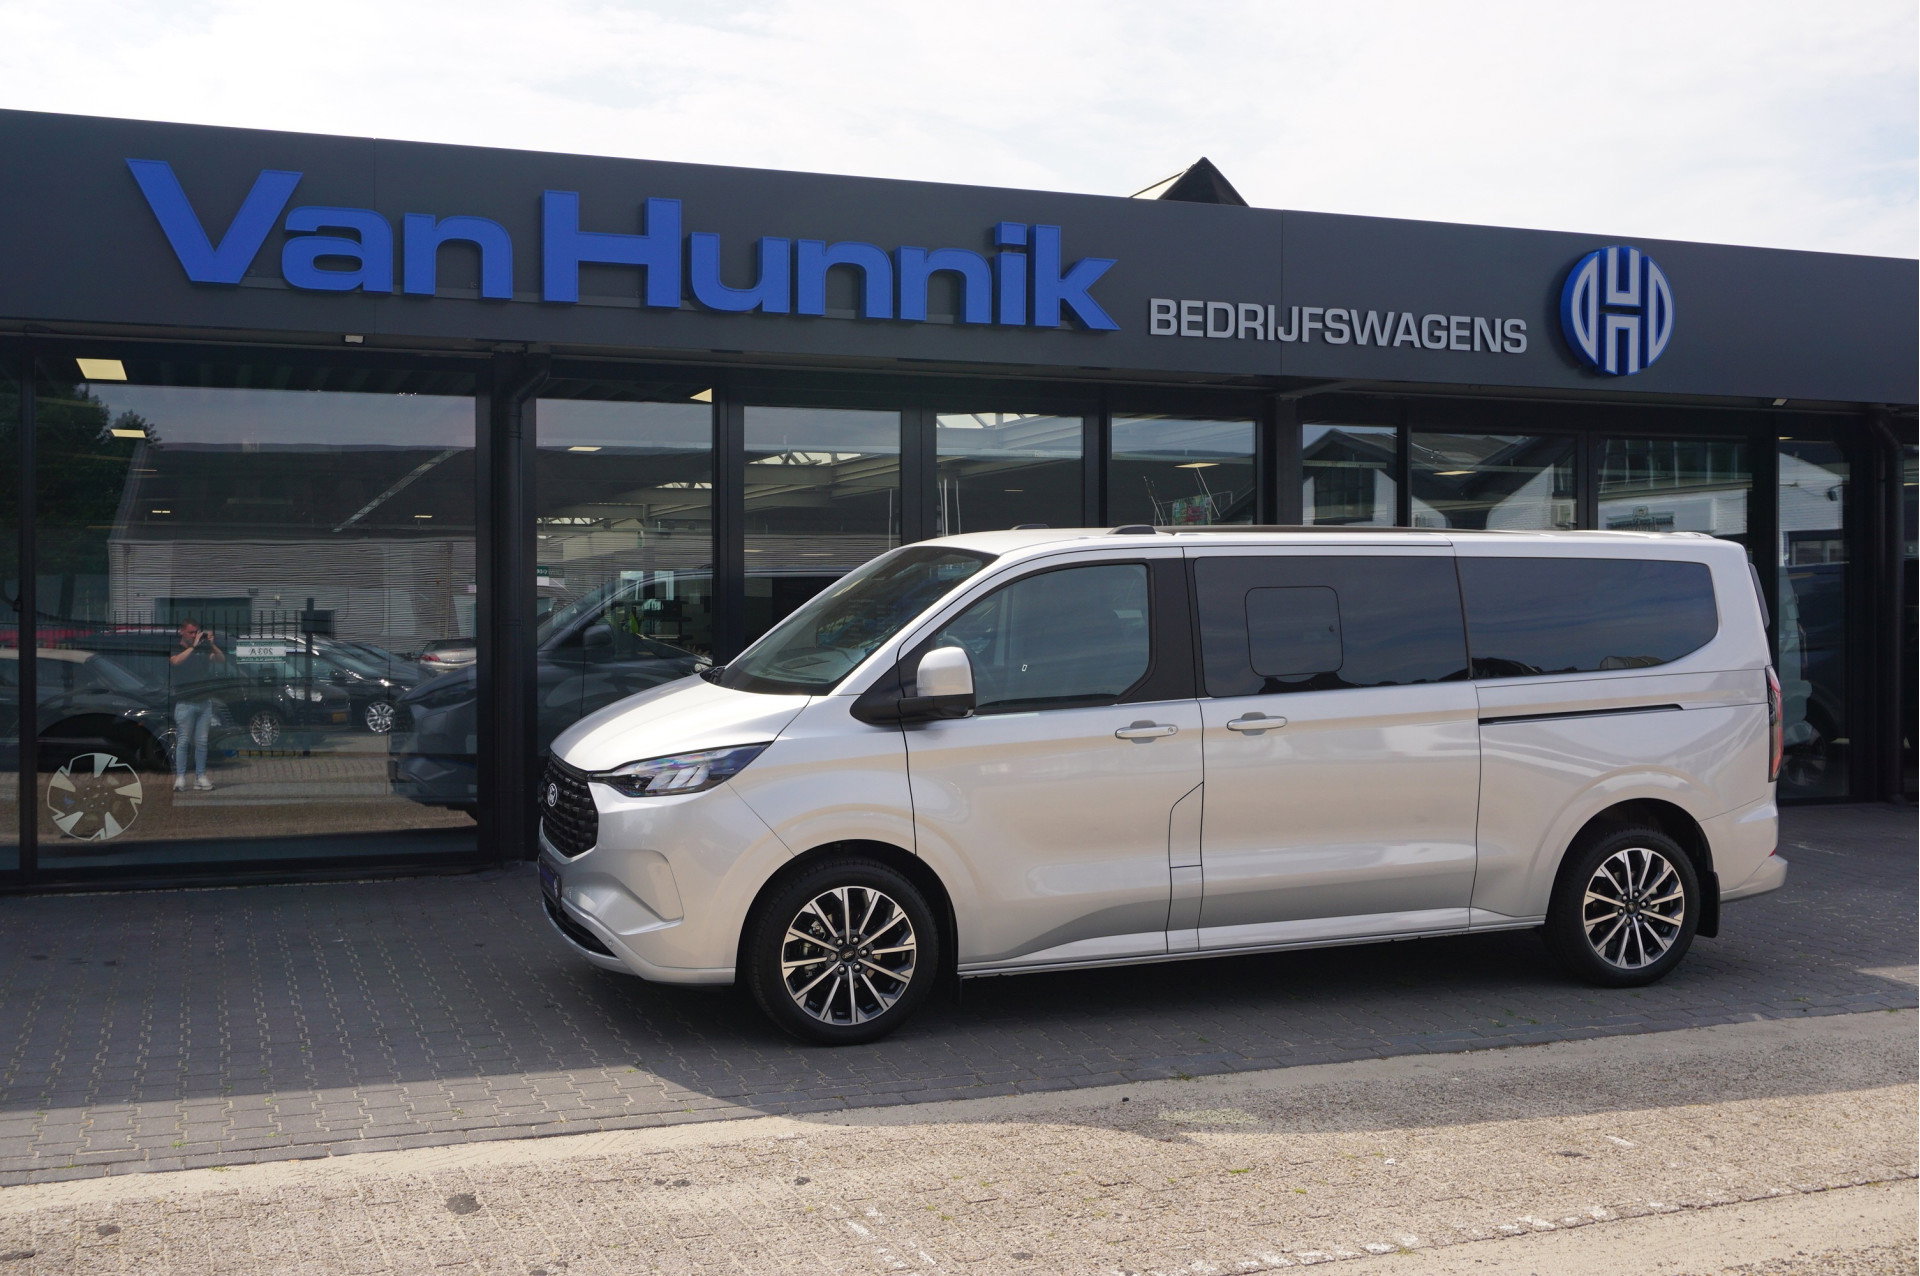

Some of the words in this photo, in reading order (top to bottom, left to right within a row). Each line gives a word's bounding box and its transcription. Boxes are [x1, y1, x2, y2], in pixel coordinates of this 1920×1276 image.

[124, 158, 513, 299] Van
[540, 189, 1122, 331] Hunnik
[1149, 298, 1528, 355] BEDRIJFSWAGENS
